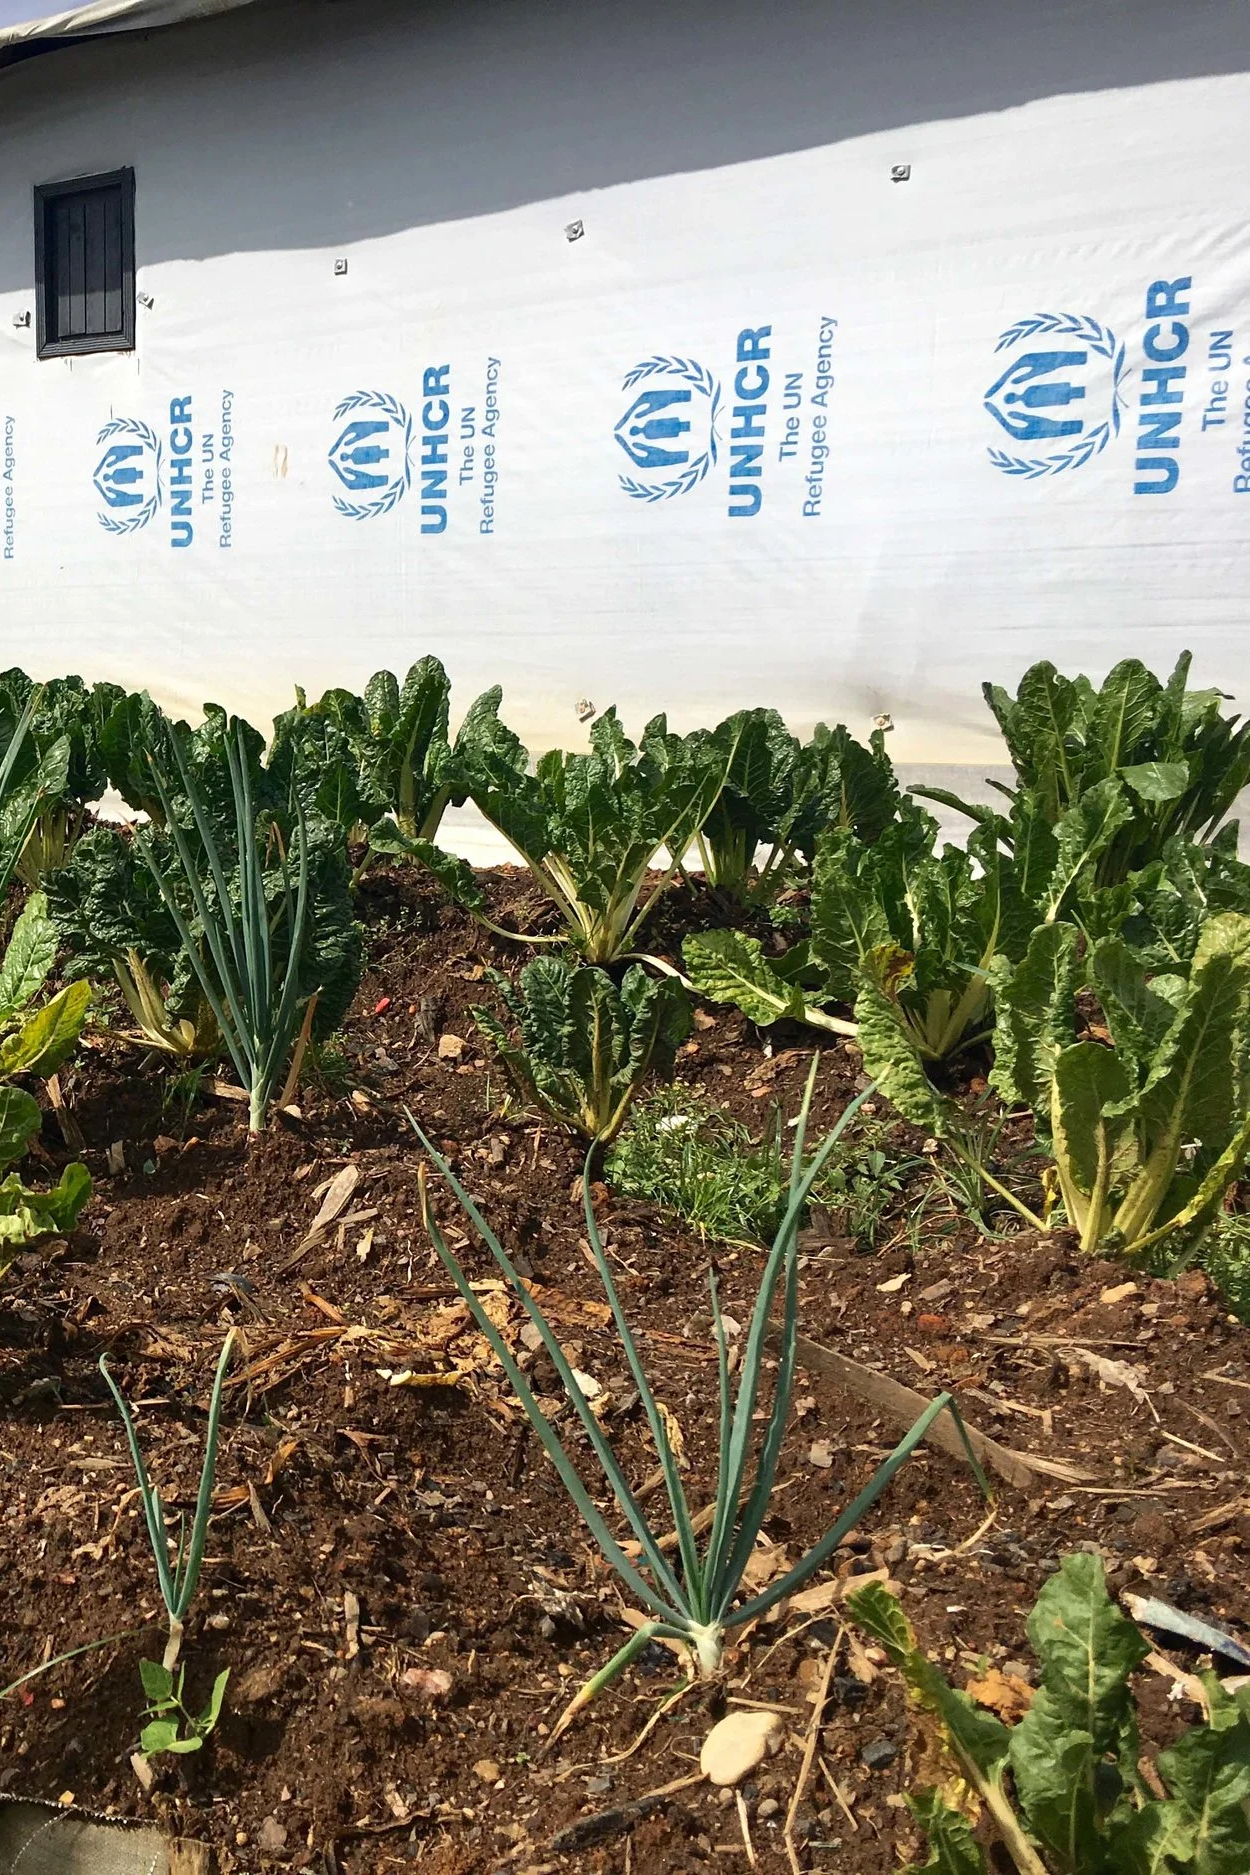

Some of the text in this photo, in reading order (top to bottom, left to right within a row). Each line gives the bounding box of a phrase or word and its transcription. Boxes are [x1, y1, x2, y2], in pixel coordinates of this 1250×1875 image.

[421, 364, 450, 534] UNHCR
[459, 407, 475, 486] The UN
[480, 357, 501, 534] Refugee Agency
[728, 325, 771, 517] UNHCR
[779, 373, 803, 462] The UN
[803, 317, 837, 516] Refugee Agency
[1134, 276, 1192, 494] UNHCR
[1202, 330, 1233, 432] The UN
[3, 416, 15, 559] Refugee Agency
[170, 396, 193, 547] UNHCR
[202, 434, 214, 504] The UN
[219, 390, 234, 547] Refugee Agency
